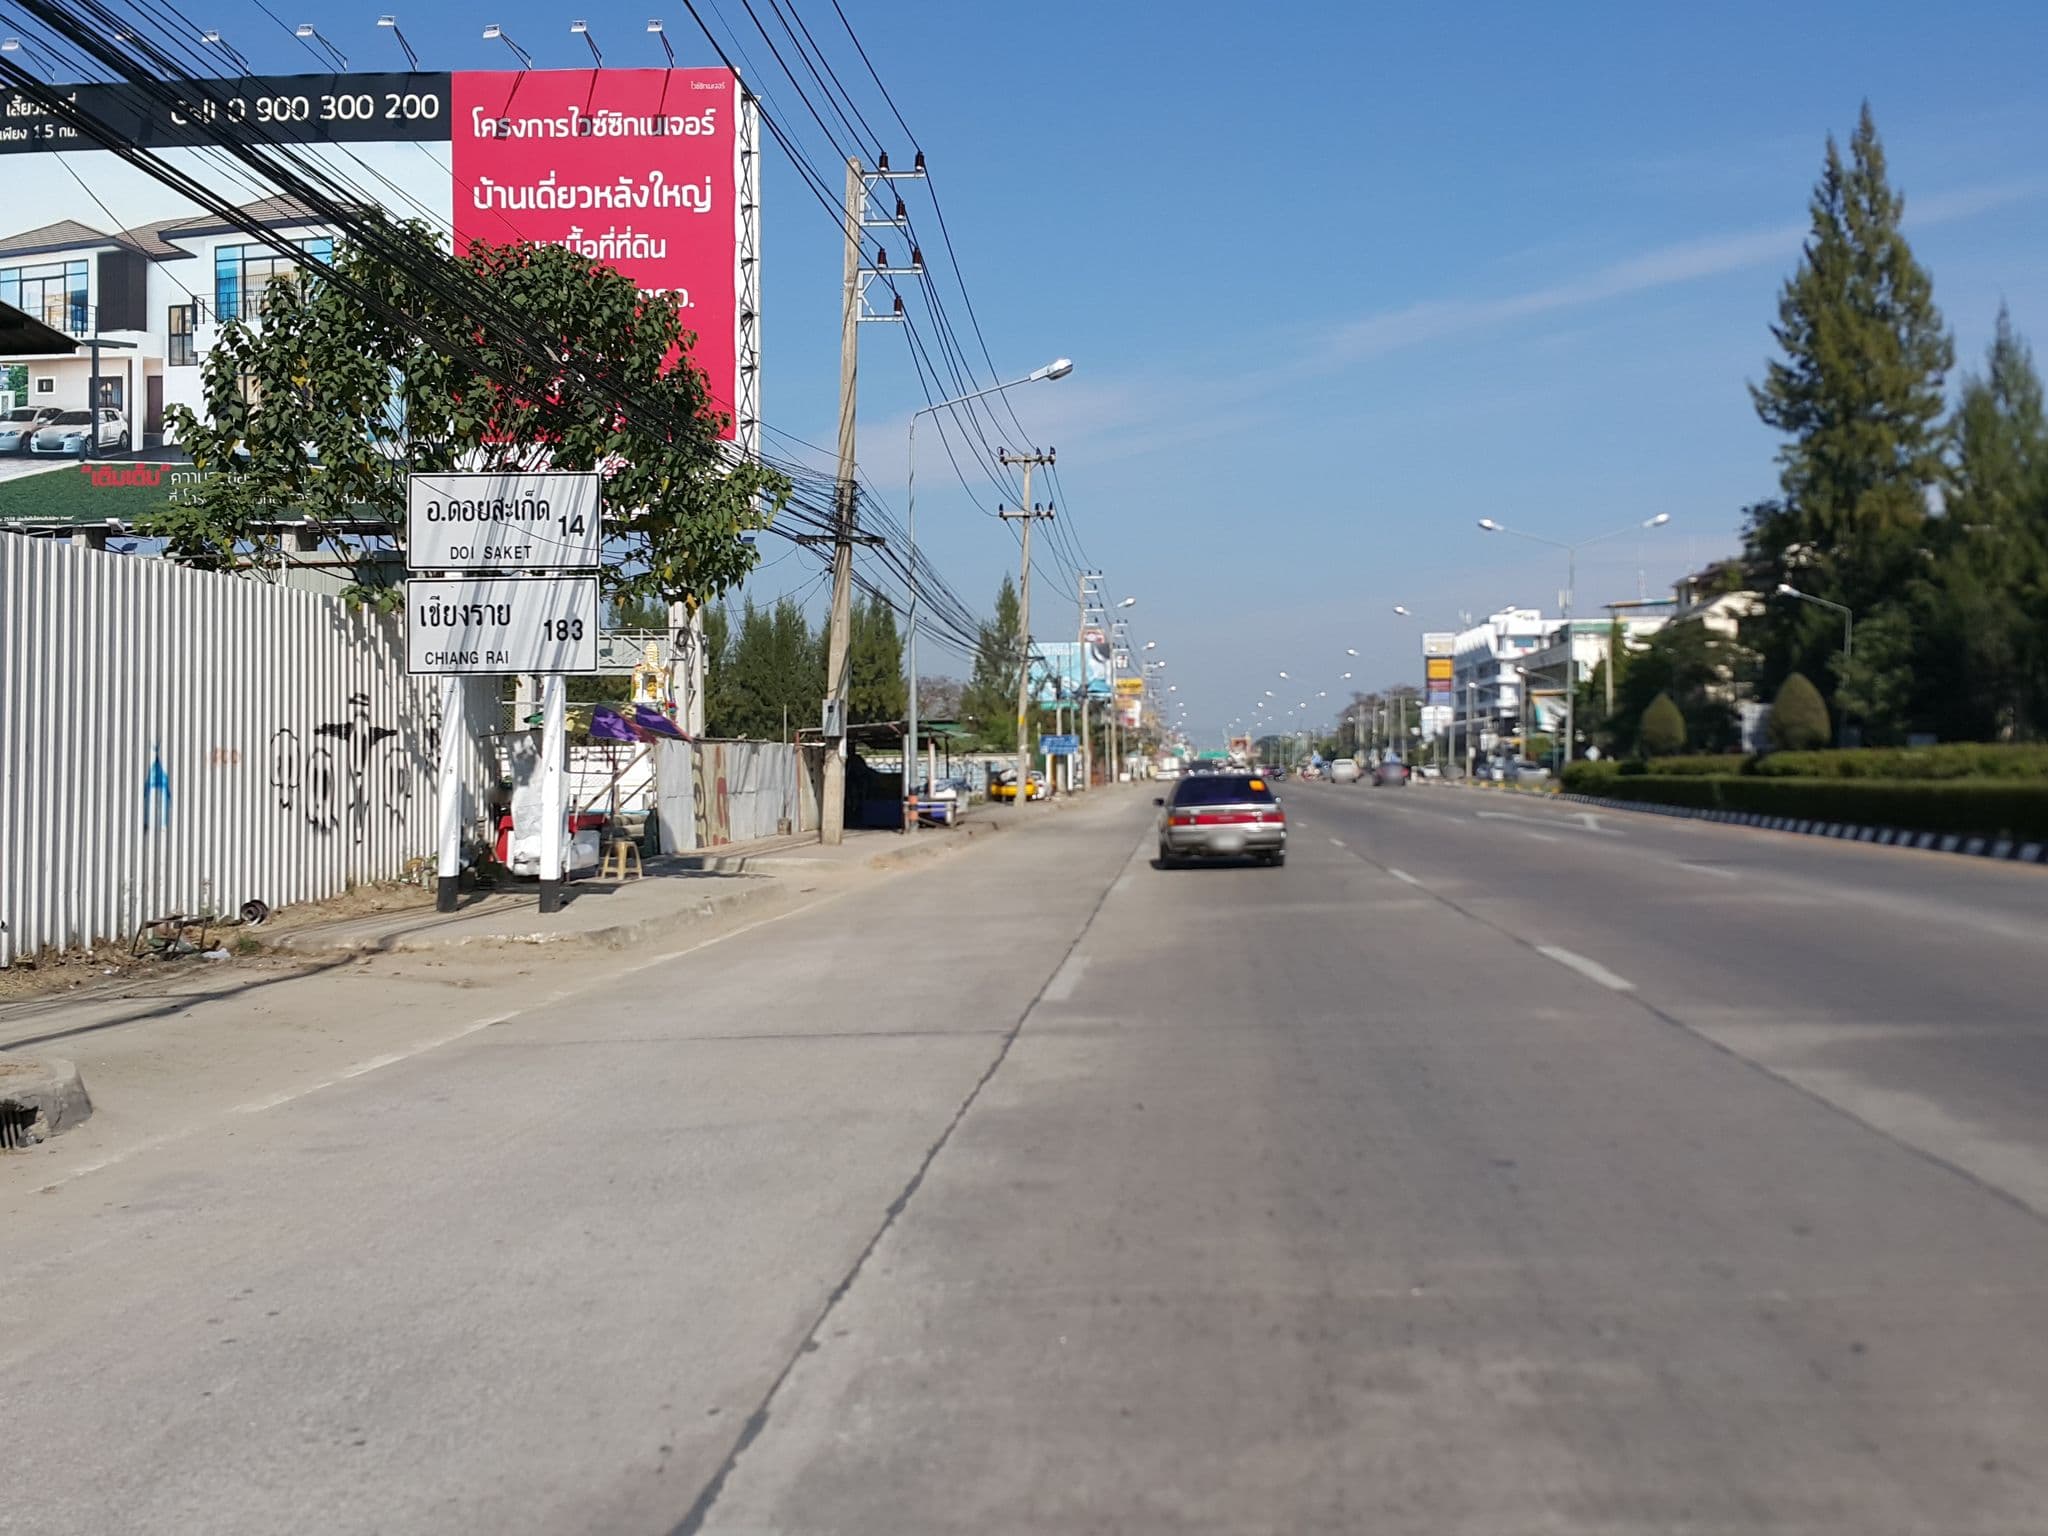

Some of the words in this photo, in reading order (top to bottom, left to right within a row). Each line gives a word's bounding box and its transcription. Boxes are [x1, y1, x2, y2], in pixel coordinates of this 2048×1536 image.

[228, 98, 246, 123] 0
[256, 96, 309, 122] 900
[319, 95, 374, 119] 300
[384, 94, 440, 119] 200
[472, 106, 716, 138] โครงการไวซ์ซิกเนเจอร์
[473, 170, 712, 213] บ้านเดี่ยวหลังใหญ่
[427, 490, 550, 522] อ.ดอยสะเก็ด
[558, 515, 585, 537] 14
[450, 546, 475, 560] DOI
[484, 545, 532, 560] SAKET
[420, 595, 511, 627] เชียงราย
[544, 619, 583, 641] 183
[425, 651, 479, 665] CHIANG
[486, 650, 509, 665] RAI
